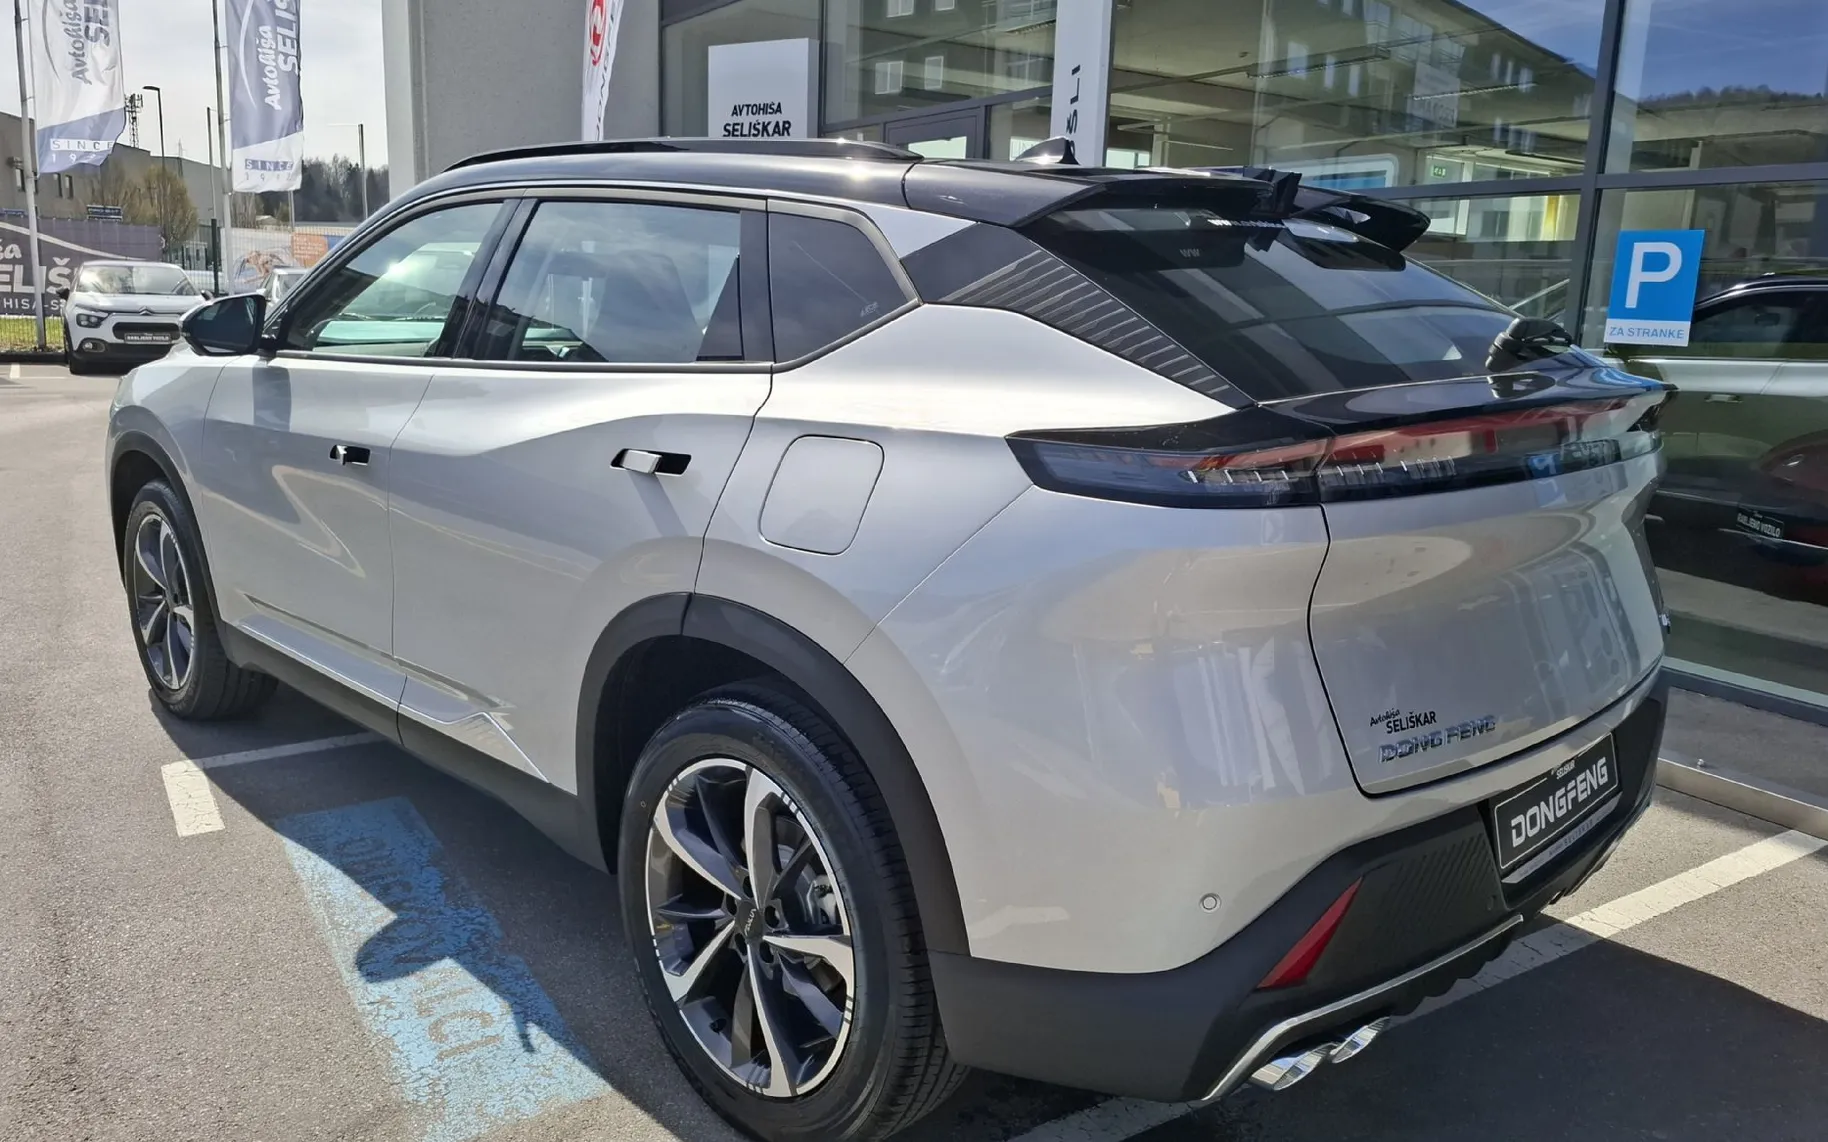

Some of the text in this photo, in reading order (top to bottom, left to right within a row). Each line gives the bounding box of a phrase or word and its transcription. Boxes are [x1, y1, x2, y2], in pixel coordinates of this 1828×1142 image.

[256, 25, 282, 110] Avtohiša
[731, 101, 783, 117] AVTOHIŠA
[722, 119, 792, 138] SELIŠKAR
[1625, 242, 1683, 309] P
[1609, 326, 1685, 339] ZA STRANKE
[1386, 711, 1437, 734] SELIŠKAR
[1511, 757, 1609, 848] DONGFENG
